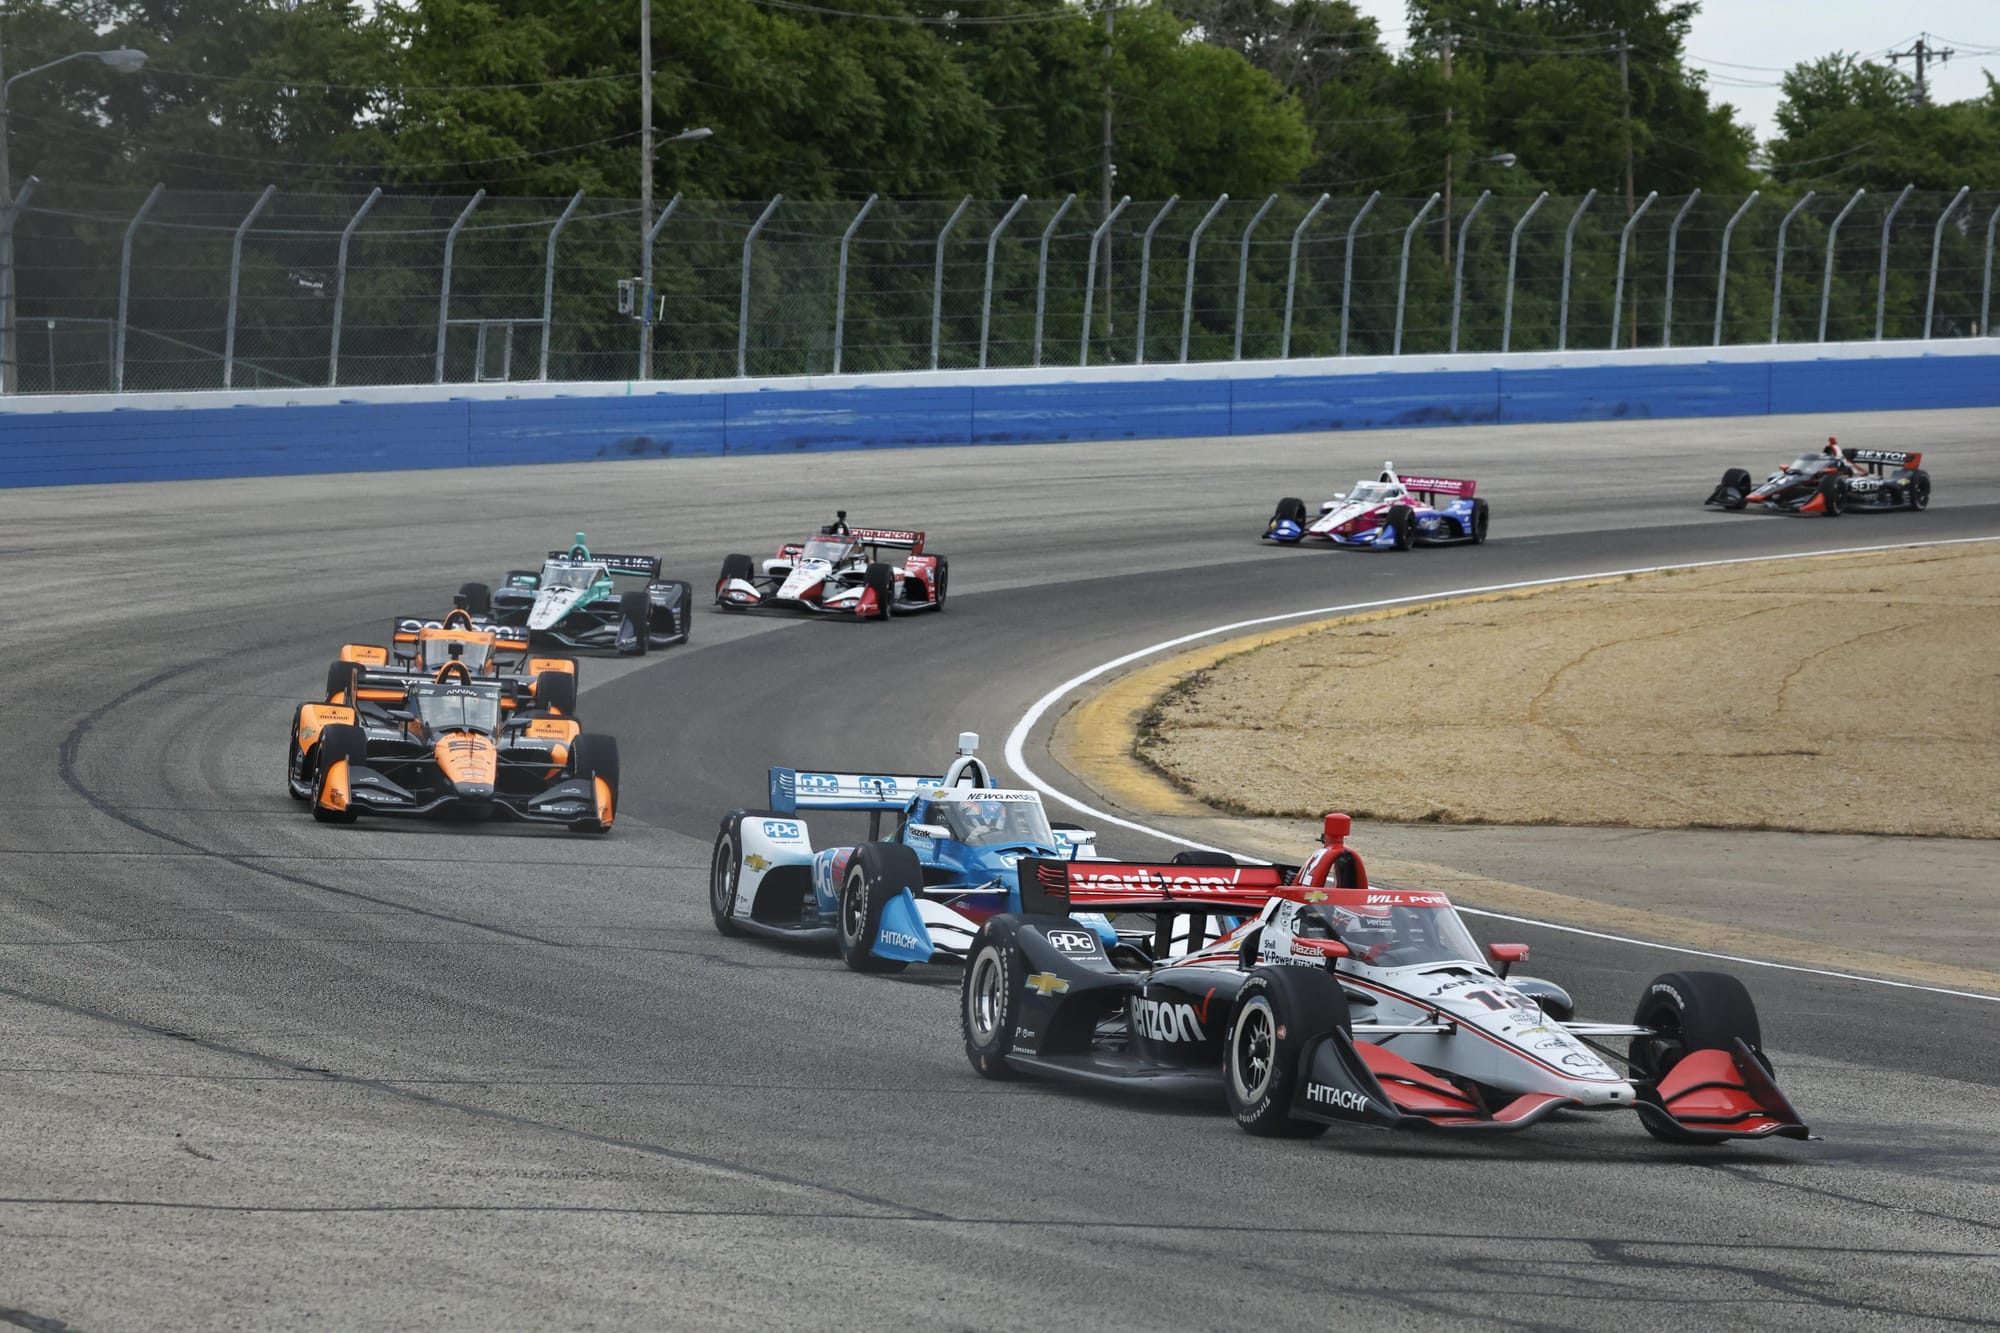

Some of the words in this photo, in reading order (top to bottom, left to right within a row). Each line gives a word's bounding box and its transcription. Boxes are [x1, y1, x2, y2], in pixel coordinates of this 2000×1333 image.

[765, 821, 799, 837] PPG
[1072, 869, 1229, 893] verizon
[1366, 895, 1404, 904] WILL
[1051, 933, 1093, 951] PPG
[1264, 939, 1276, 949] Shell
[1306, 1082, 1369, 1112] HITACHI
